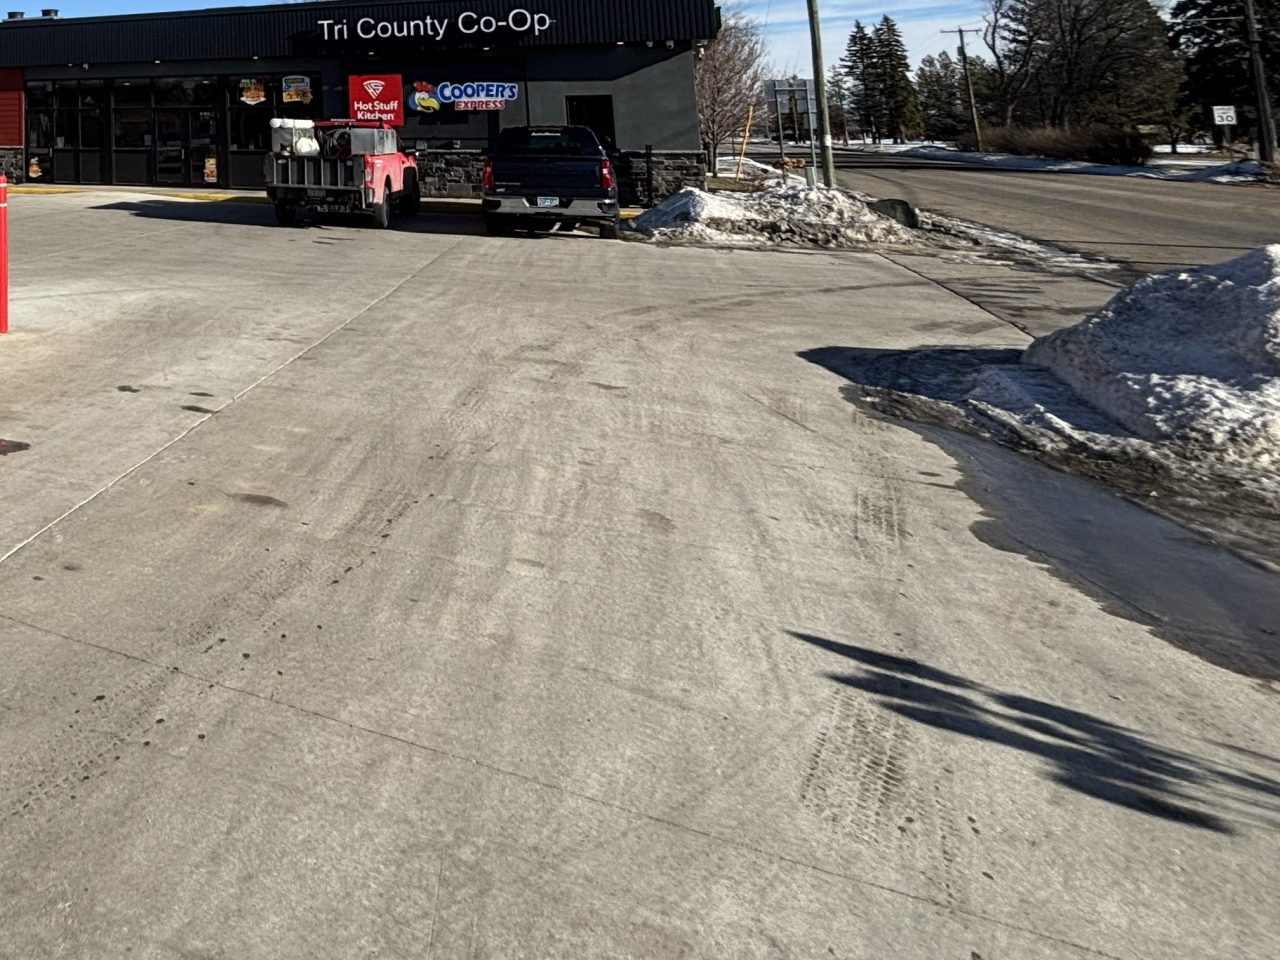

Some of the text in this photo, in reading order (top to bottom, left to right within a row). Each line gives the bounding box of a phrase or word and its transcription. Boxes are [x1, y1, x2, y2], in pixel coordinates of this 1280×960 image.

[317, 8, 551, 40] Tri County Co-Op
[438, 82, 518, 102] COOPER'S
[354, 100, 398, 110] Hot Stuff
[455, 100, 505, 110] EXPRESS
[357, 111, 395, 120] Kitchen
